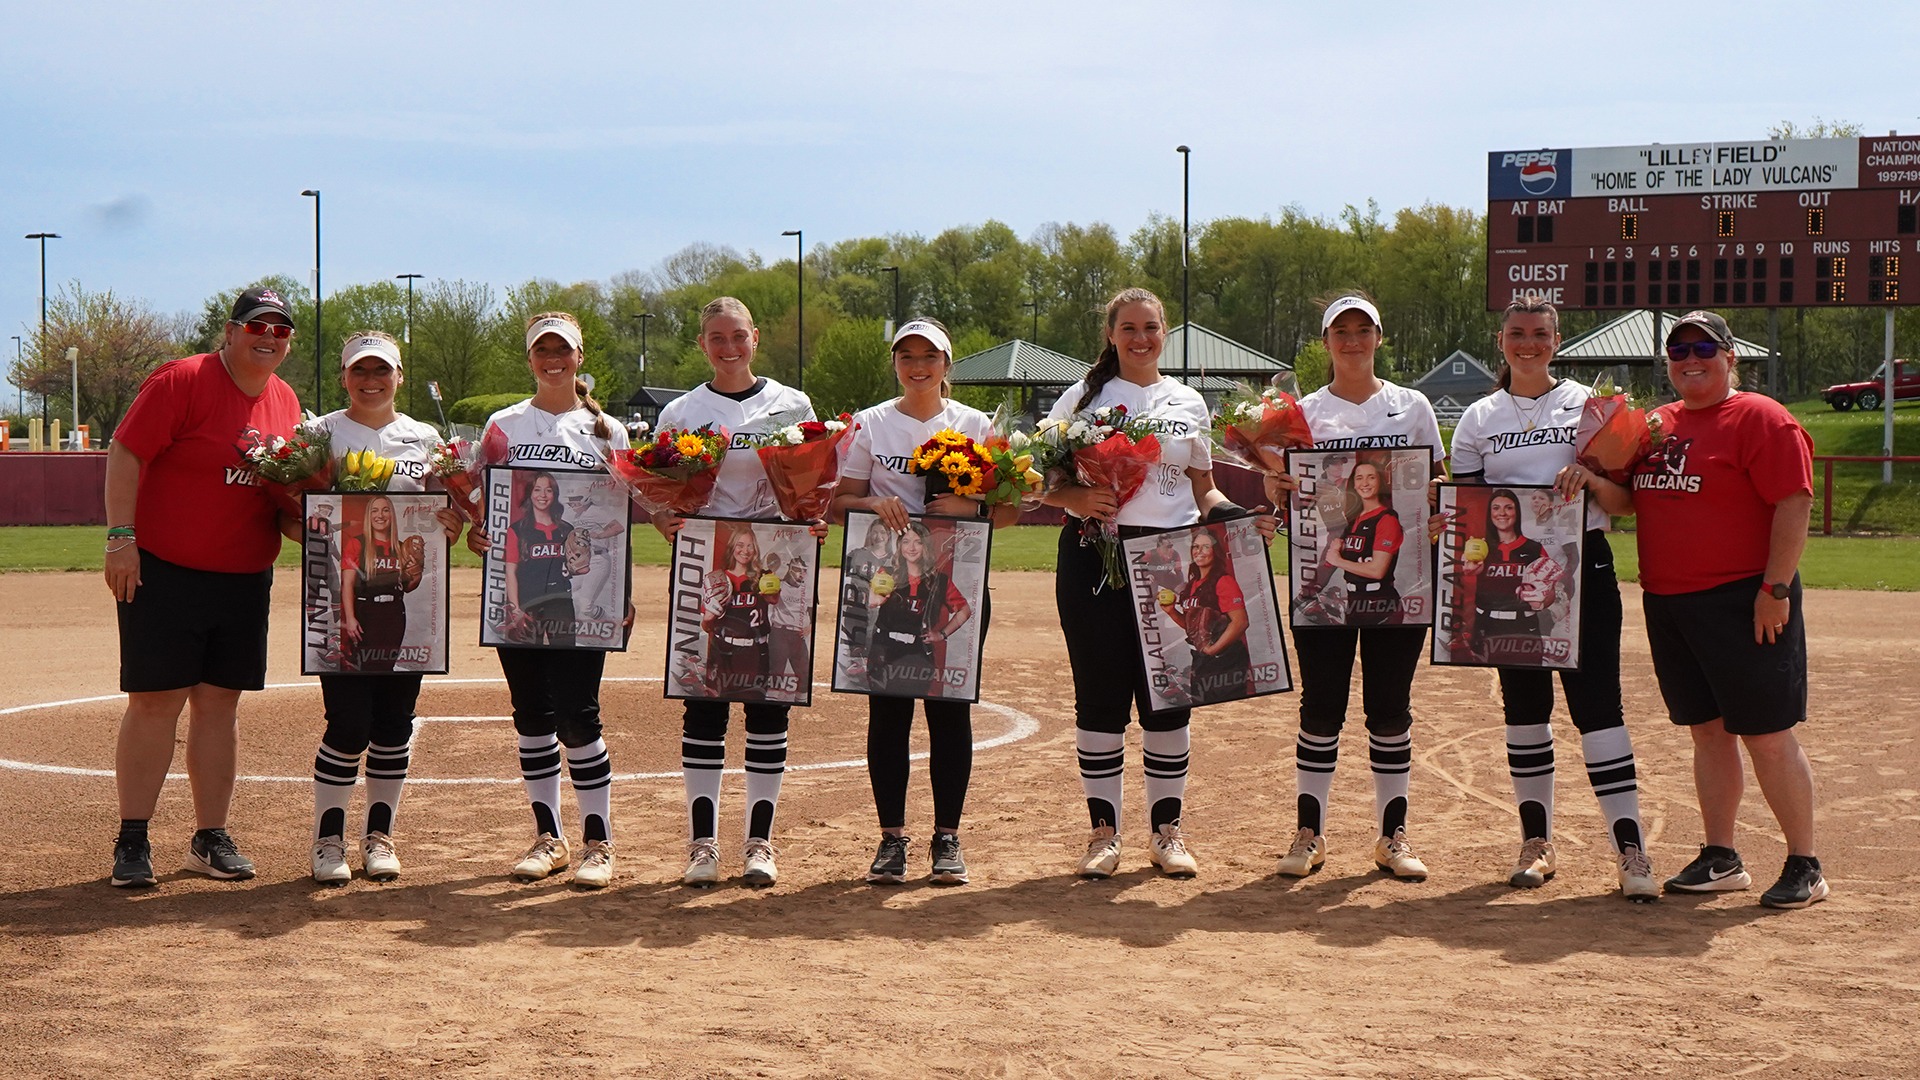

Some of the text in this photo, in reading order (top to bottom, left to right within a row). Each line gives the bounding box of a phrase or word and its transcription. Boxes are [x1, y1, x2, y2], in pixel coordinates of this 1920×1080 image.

[1502, 152, 1557, 167] PEPSI
[1717, 145, 1786, 164] FIELD"
[1591, 165, 1838, 190] "HOME OF THE LADY VULCANS"
[1511, 200, 1565, 215] AT BAT
[1609, 198, 1649, 212] BALL
[1701, 194, 1757, 210] STRIKE
[1799, 192, 1831, 207] OUT
[1622, 214, 1637, 240] 0
[1718, 211, 1734, 237] 0
[1808, 208, 1823, 235] 0
[1589, 240, 1900, 259] 1 2 3 4 5 6 7 8 9 10 RUNS HITS
[1508, 264, 1568, 282] GUEST
[1833, 257, 1845, 277] 0
[1886, 256, 1898, 276] 0
[1512, 288, 1564, 304] HOME
[508, 444, 595, 468] VULCANS
[1633, 474, 1701, 493] VULCANS
[488, 482, 510, 622] SCHLOSSER
[308, 516, 329, 650] LINKOUS
[674, 535, 706, 655] NIDOH
[1346, 597, 1423, 615] VULCANS
[536, 618, 615, 638] VULCANS
[1130, 551, 1170, 688] BLACKBURN
[360, 647, 431, 664] VULCANS
[1488, 637, 1570, 656] VULCANS
[721, 672, 799, 691] VULCANS
[887, 664, 967, 686] VULCANS
[1201, 664, 1278, 692] VULCANS
